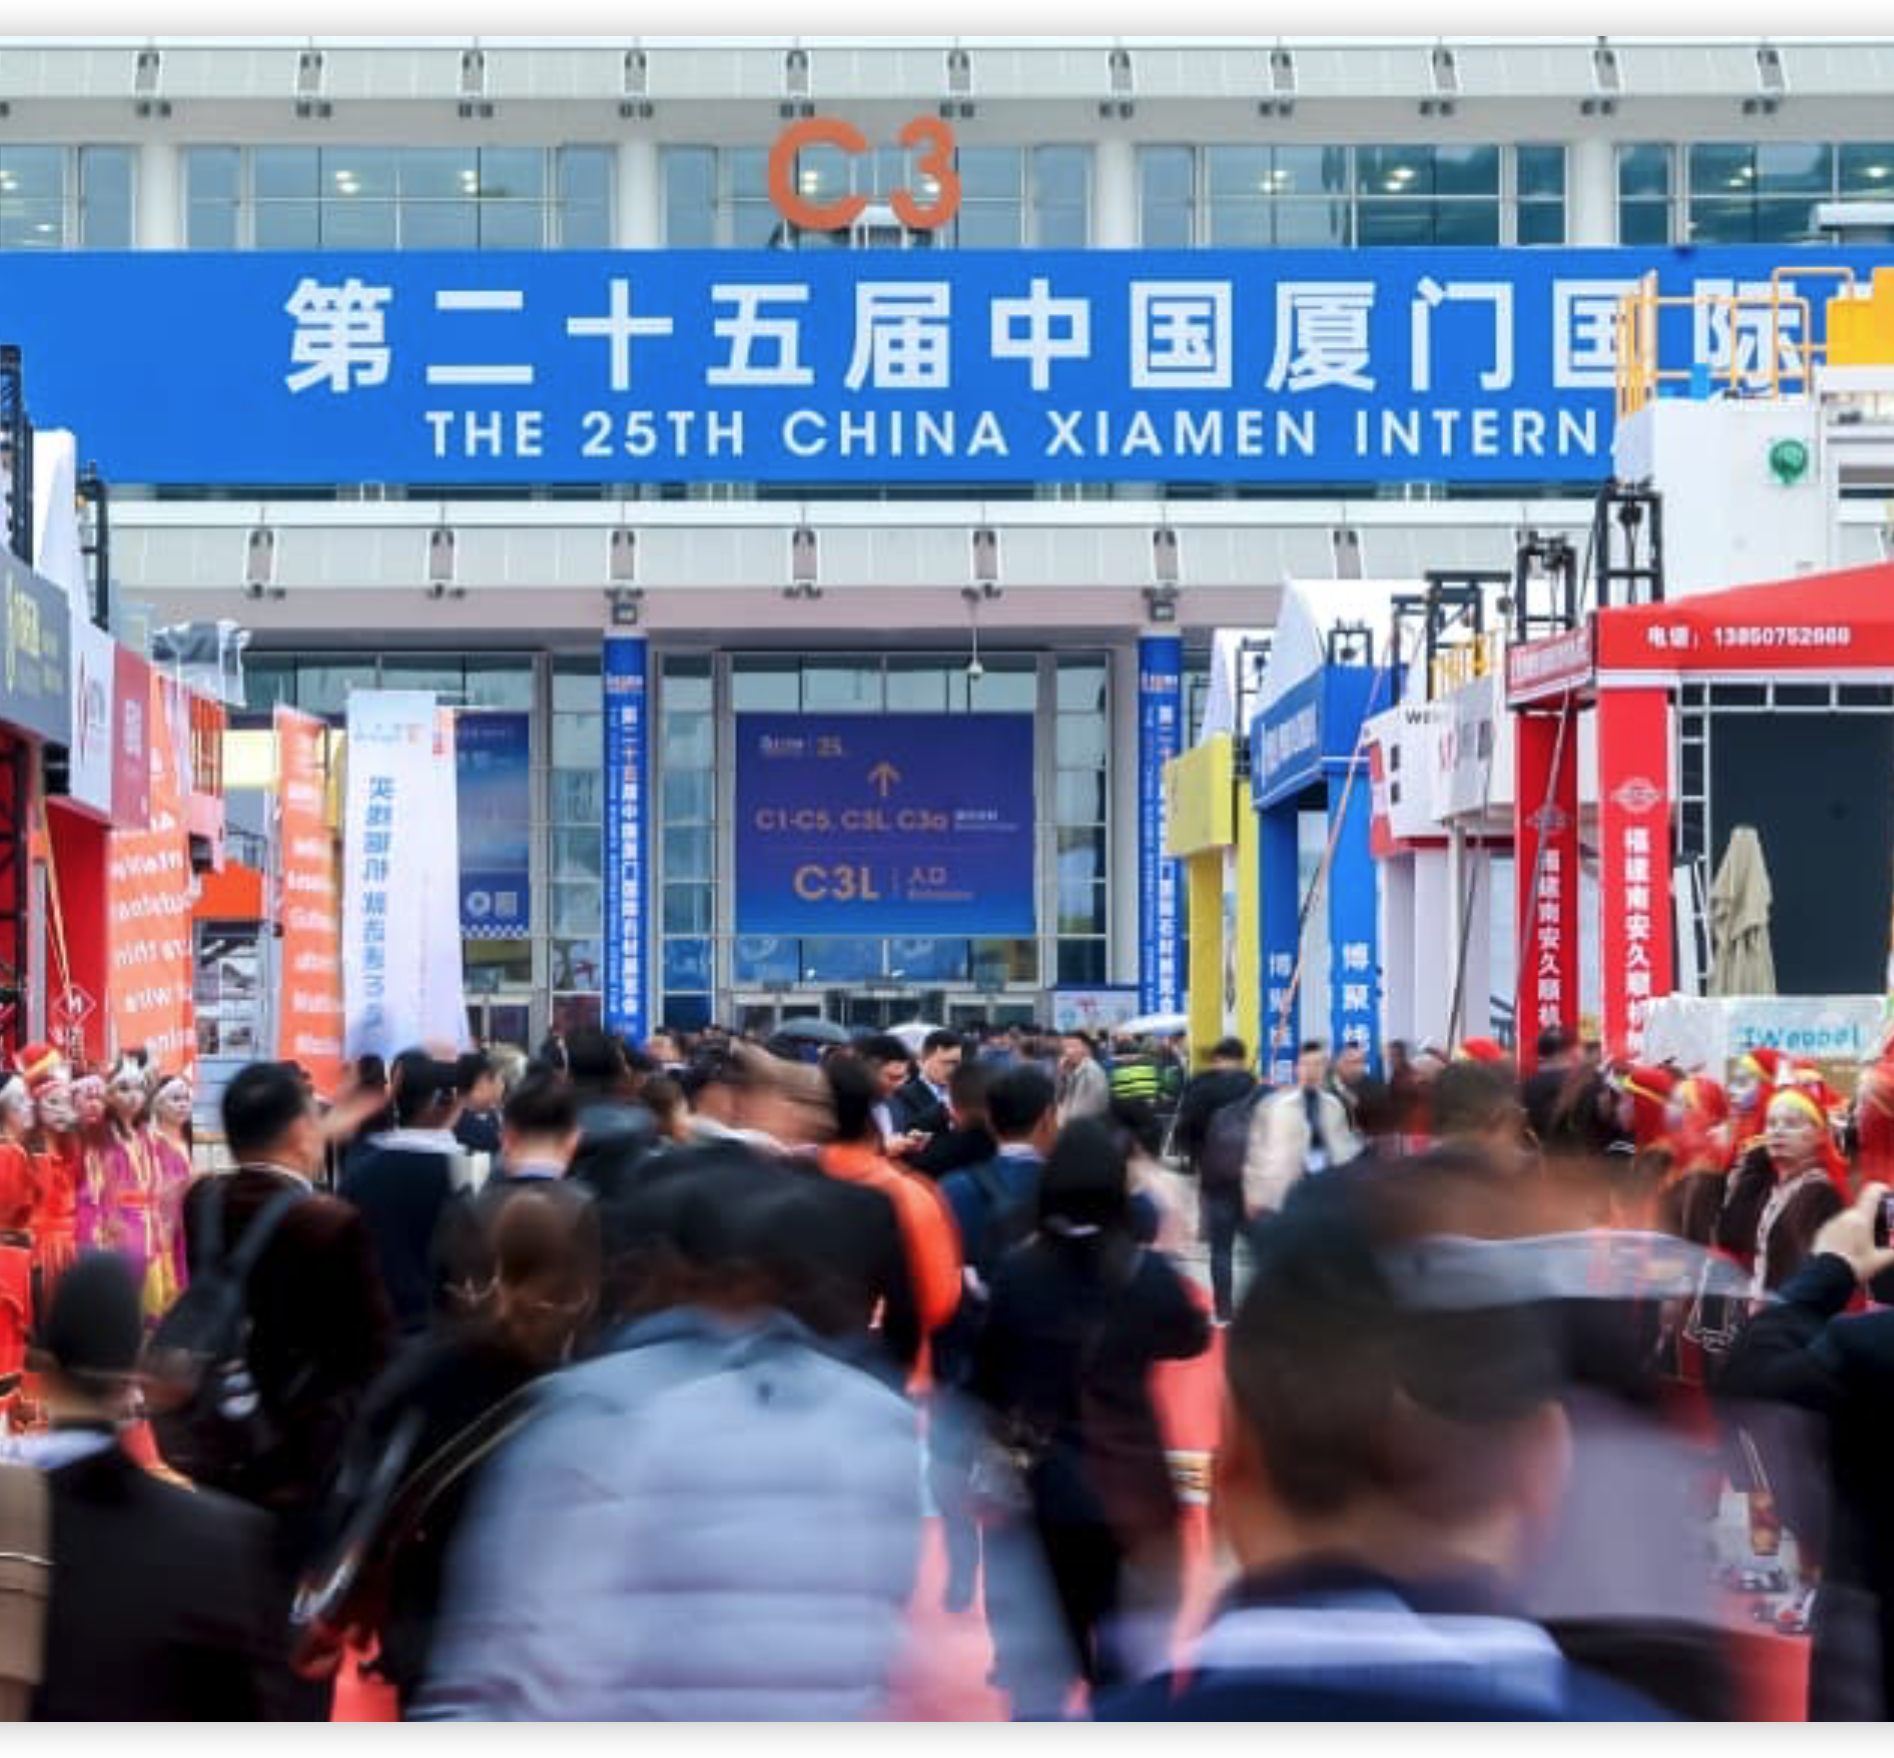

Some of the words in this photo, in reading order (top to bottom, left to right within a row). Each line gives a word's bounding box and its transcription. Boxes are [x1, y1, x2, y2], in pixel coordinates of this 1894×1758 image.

[769, 116, 962, 231] C3
[285, 277, 1874, 398] 第二十五届中国厦门国际
[426, 410, 542, 457] THE
[582, 409, 743, 458] 25TH
[783, 409, 1008, 458] CHINA
[1047, 410, 1315, 457] XIAMEN
[1357, 410, 1614, 457] INTERN
[793, 863, 882, 901] C3L
